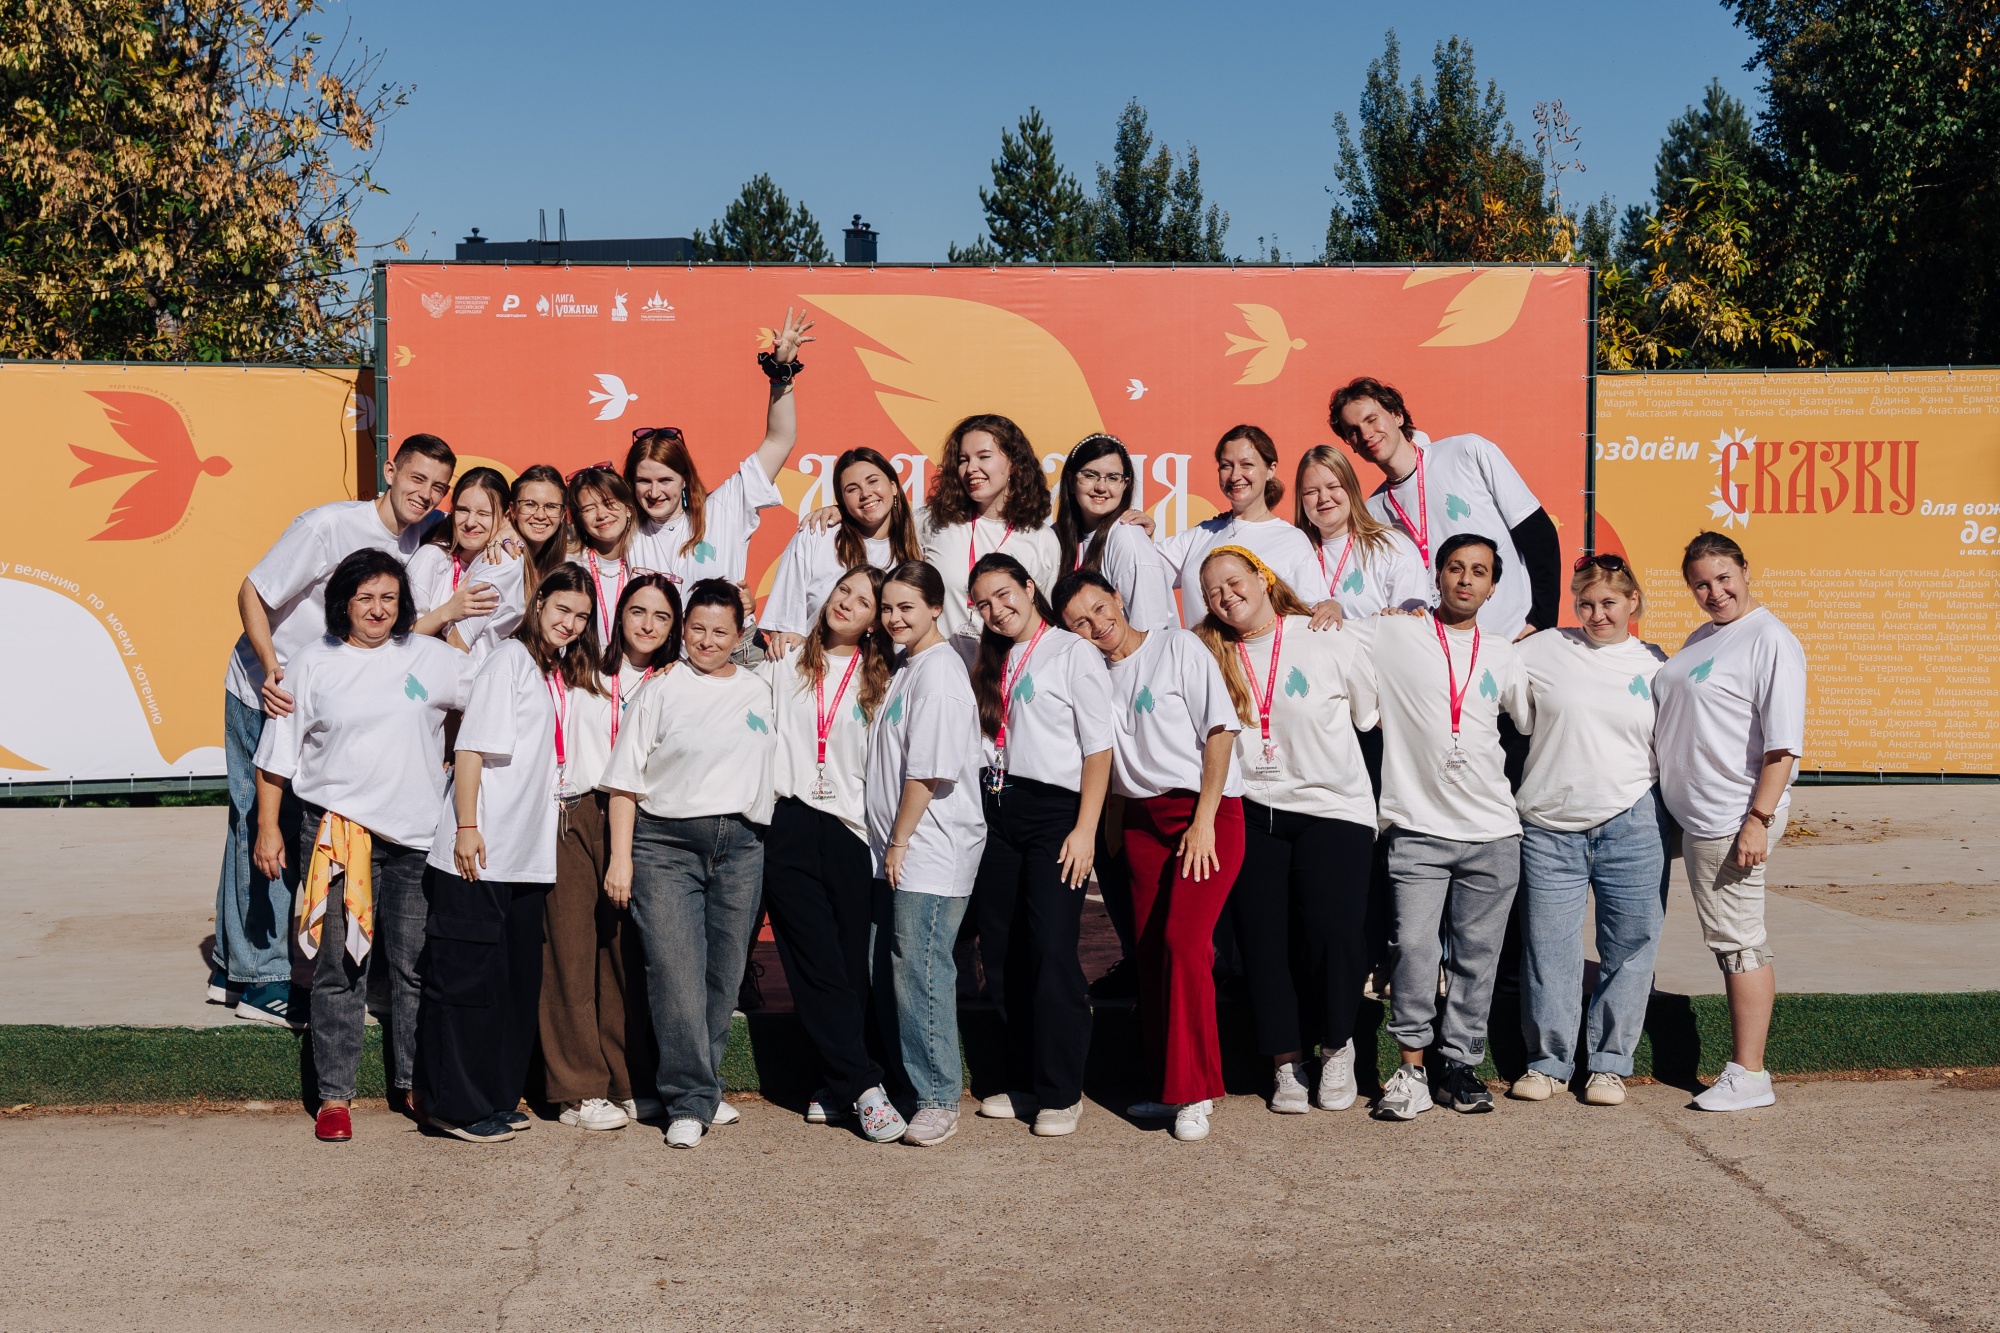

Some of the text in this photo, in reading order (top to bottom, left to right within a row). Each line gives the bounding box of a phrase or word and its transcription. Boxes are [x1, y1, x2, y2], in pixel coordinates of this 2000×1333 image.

[555, 294, 575, 303] ЛИГА
[1599, 379, 1648, 388] Андреева
[1652, 374, 1694, 386] Евгения
[1696, 377, 1764, 387] Багаутдинова
[1768, 376, 1810, 385] Алексей
[1814, 376, 1869, 386] Бакуменко
[1873, 372, 1899, 383] Анна
[1903, 370, 1956, 382] Белявская
[1597, 389, 1634, 399] улычев
[1638, 388, 1672, 396] Регина
[1676, 388, 1728, 397] Ващекина
[1731, 386, 1756, 395] Анна
[1761, 386, 1824, 397] Вешкурцева
[1828, 386, 1880, 395] Елизавета
[1884, 385, 1942, 396] Воронцова
[1946, 384, 1992, 392] Камилла
[1604, 395, 2000, 409] Мария Гордеева Ольга Горичева Екатерина Дудина Жанна Ермако
[1682, 409, 1723, 417] Агапова
[1733, 408, 1774, 416] Татьяна
[1779, 407, 1828, 417] Скрябина
[1834, 407, 1864, 416] Елена
[1869, 407, 1922, 416] Смирнова
[1928, 406, 1981, 414] Анастасия
[1596, 436, 1699, 461] оздаём
[1920, 499, 1957, 516] для
[1963, 503, 2000, 516] вож
[1960, 520, 2000, 544] де
[1646, 568, 1683, 576] Наталь
[1762, 568, 1806, 578] Даниэль
[1810, 568, 1841, 576] Капов
[1844, 568, 1876, 577] Алена
[1880, 568, 1938, 579] Капусткина
[1942, 568, 1974, 579] Дарья
[1646, 578, 1686, 586] Светлан
[1749, 580, 1796, 589] катерина
[1801, 579, 1854, 589] Карсакова
[1859, 579, 1893, 590] Мария
[1898, 580, 1952, 590] Колупаева
[1957, 579, 1990, 590] Дарья
[1773, 589, 1809, 598] Ксения
[1819, 590, 1875, 600] Кукушкина
[1885, 590, 1910, 598] Анна
[1920, 590, 1984, 600] Куприянова
[1898, 600, 1928, 608] Елена
[1645, 610, 1692, 620] Кристина
[1774, 610, 1816, 620] Валерия
[1824, 610, 1874, 619] Матвеева
[1882, 610, 1911, 619] Юлия
[1919, 611, 1988, 620] Меньшикова
[1645, 620, 1676, 628] Лилия
[1818, 621, 1875, 631] Могилевец
[1884, 622, 1936, 630] Анастасия
[1946, 622, 1986, 632] Мухина
[1645, 630, 1686, 640] Валерия
[1837, 632, 1875, 642] Тамара
[1878, 632, 1933, 642] Некрасова
[1936, 632, 1968, 643] Дарья
[14, 563, 163, 725] велению, по моему хотению
[1815, 642, 1848, 652] Арина
[1853, 642, 1892, 651] Панина
[1946, 644, 2000, 654] Патрушев
[1846, 653, 1902, 661] Помазкина
[1919, 654, 1962, 662] Наталья
[1859, 664, 1913, 674] Екатерина
[1926, 664, 1989, 673] Селиванова
[1814, 674, 1863, 684] Харькина
[1878, 674, 1932, 685] Екатерина
[1818, 686, 1998, 696] Черногорец Анна Мишланова
[1821, 696, 1872, 707] Макарова
[1890, 698, 1923, 706] Алина
[1933, 698, 1988, 708] Шафикова
[1819, 707, 1867, 719] Виктория
[1872, 707, 1921, 716] Зайченко
[1925, 708, 1969, 719] Эльвира
[1974, 708, 2000, 717] Земл
[1849, 718, 1878, 726] Юлия
[1886, 718, 1936, 729] Джураева
[1945, 719, 1977, 731] Дарья
[1985, 720, 2000, 729] До
[1870, 728, 1920, 739] Вероника
[1931, 730, 1990, 740] Тимофеева
[1811, 738, 1836, 746] Анна
[1840, 739, 1877, 749] Чухина
[1888, 740, 1942, 748] Анастасия
[1877, 750, 1932, 761] Александр
[1944, 751, 1993, 761] Дегтярев
[1862, 761, 1908, 771] Каримов
[1960, 762, 1992, 770] Элина
